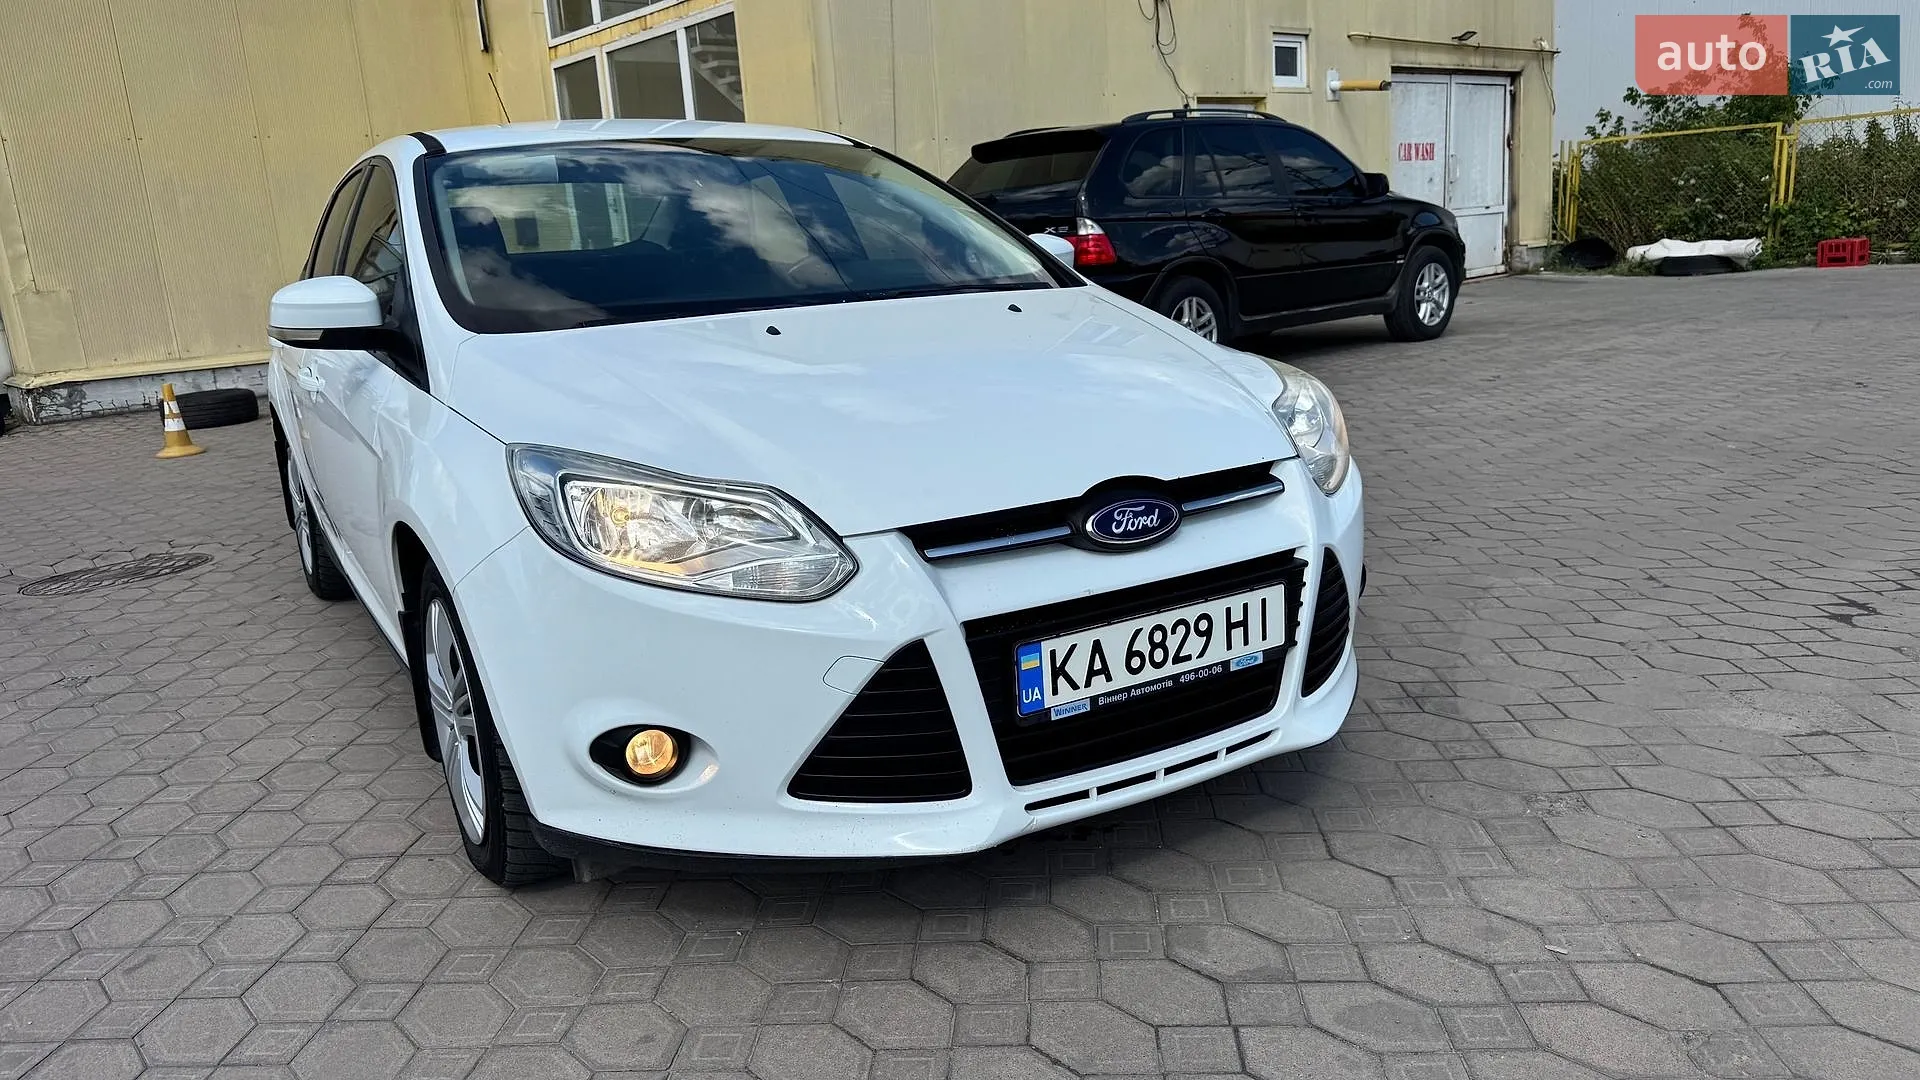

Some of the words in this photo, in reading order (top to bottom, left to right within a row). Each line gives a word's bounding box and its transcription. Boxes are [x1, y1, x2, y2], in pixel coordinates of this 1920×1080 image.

[1398, 142, 1412, 162] CAR
[1414, 142, 1435, 161] WASH
[1111, 505, 1161, 535] Ford
[1049, 638, 1113, 697] KA
[1124, 612, 1214, 676] 6829
[1225, 597, 1268, 651] HI
[1179, 664, 1223, 683] 496-00-06
[1022, 686, 1042, 704] UA
